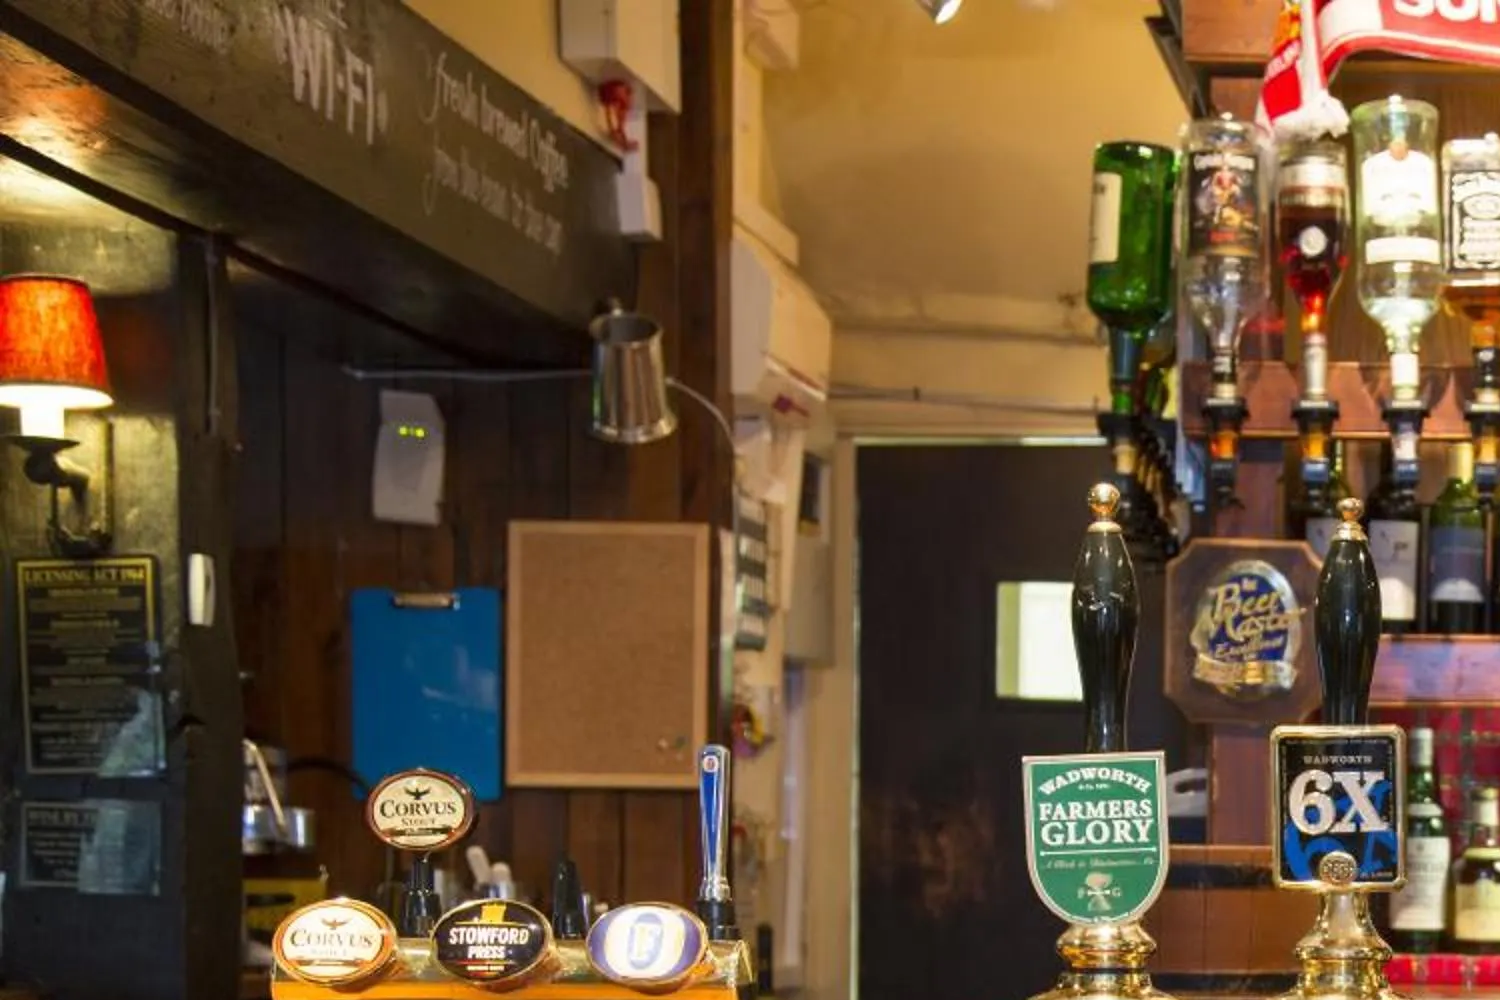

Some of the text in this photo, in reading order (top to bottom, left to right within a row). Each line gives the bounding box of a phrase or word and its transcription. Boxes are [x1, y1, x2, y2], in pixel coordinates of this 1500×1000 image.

[1038, 767, 1152, 796] WADWORTH
[1039, 799, 1153, 821] FARMERS
[1289, 769, 1389, 836] 6X
[1041, 819, 1153, 846] GLORY
[449, 926, 529, 946] STOWFORD
[467, 945, 506, 959] PRESS
